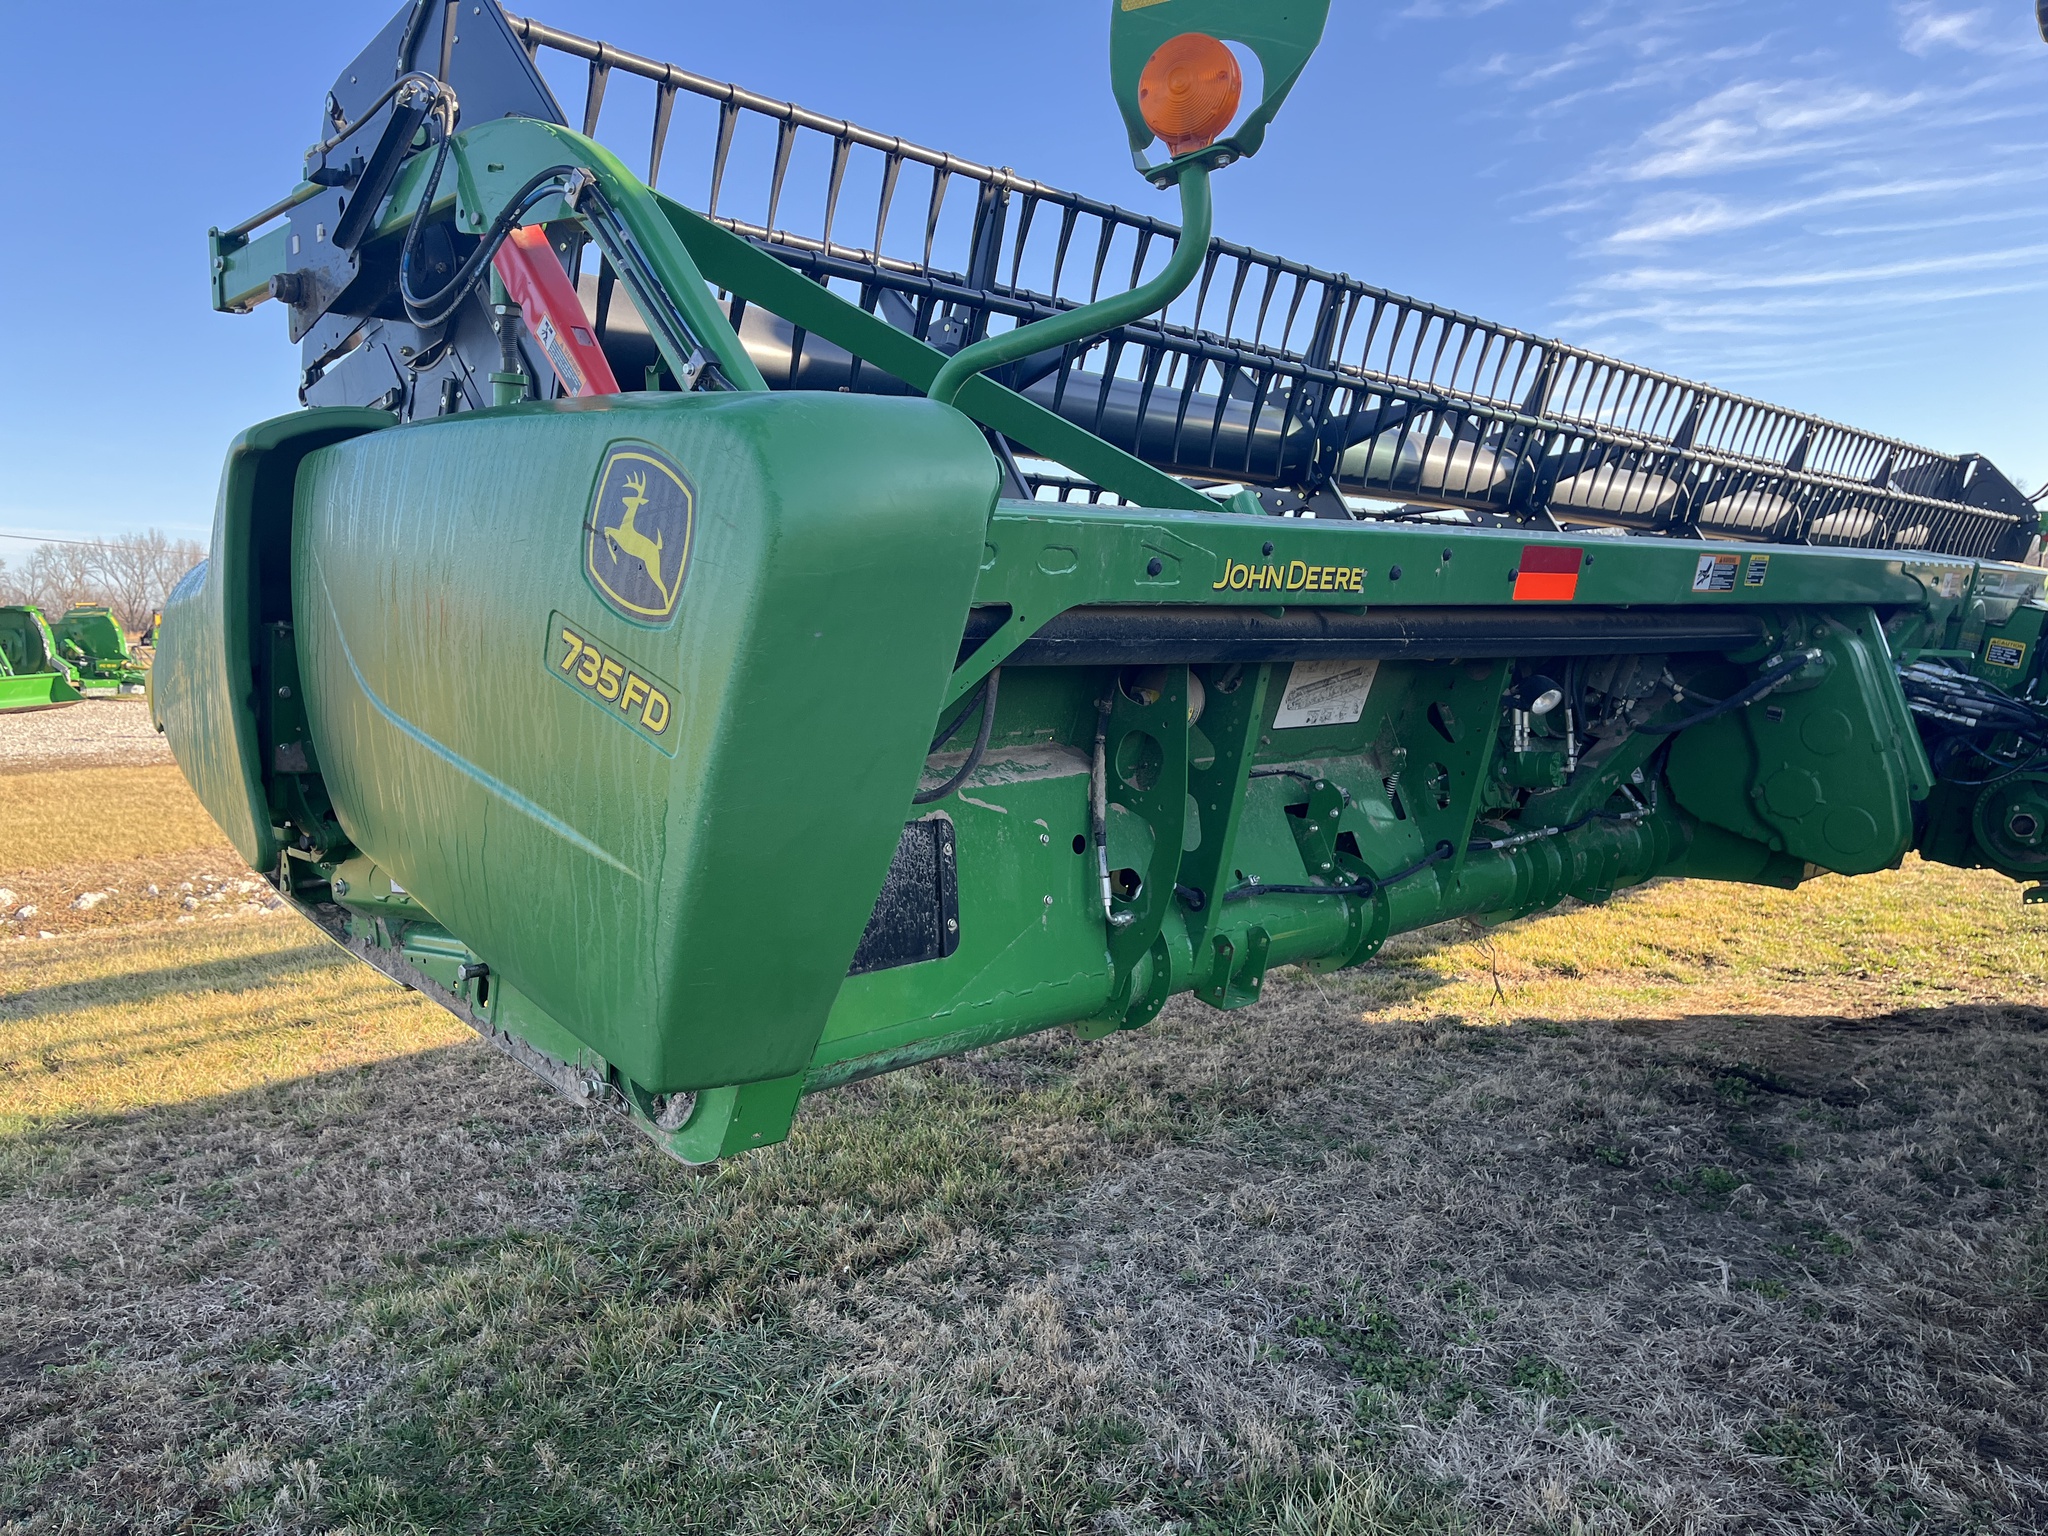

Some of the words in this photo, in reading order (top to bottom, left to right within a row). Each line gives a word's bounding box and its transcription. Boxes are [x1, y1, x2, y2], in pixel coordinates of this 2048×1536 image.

[1212, 558, 1286, 592] JOHN
[1286, 560, 1366, 593] DEERE
[1997, 639, 2024, 649] CAUTION
[561, 627, 671, 736] 735FD
